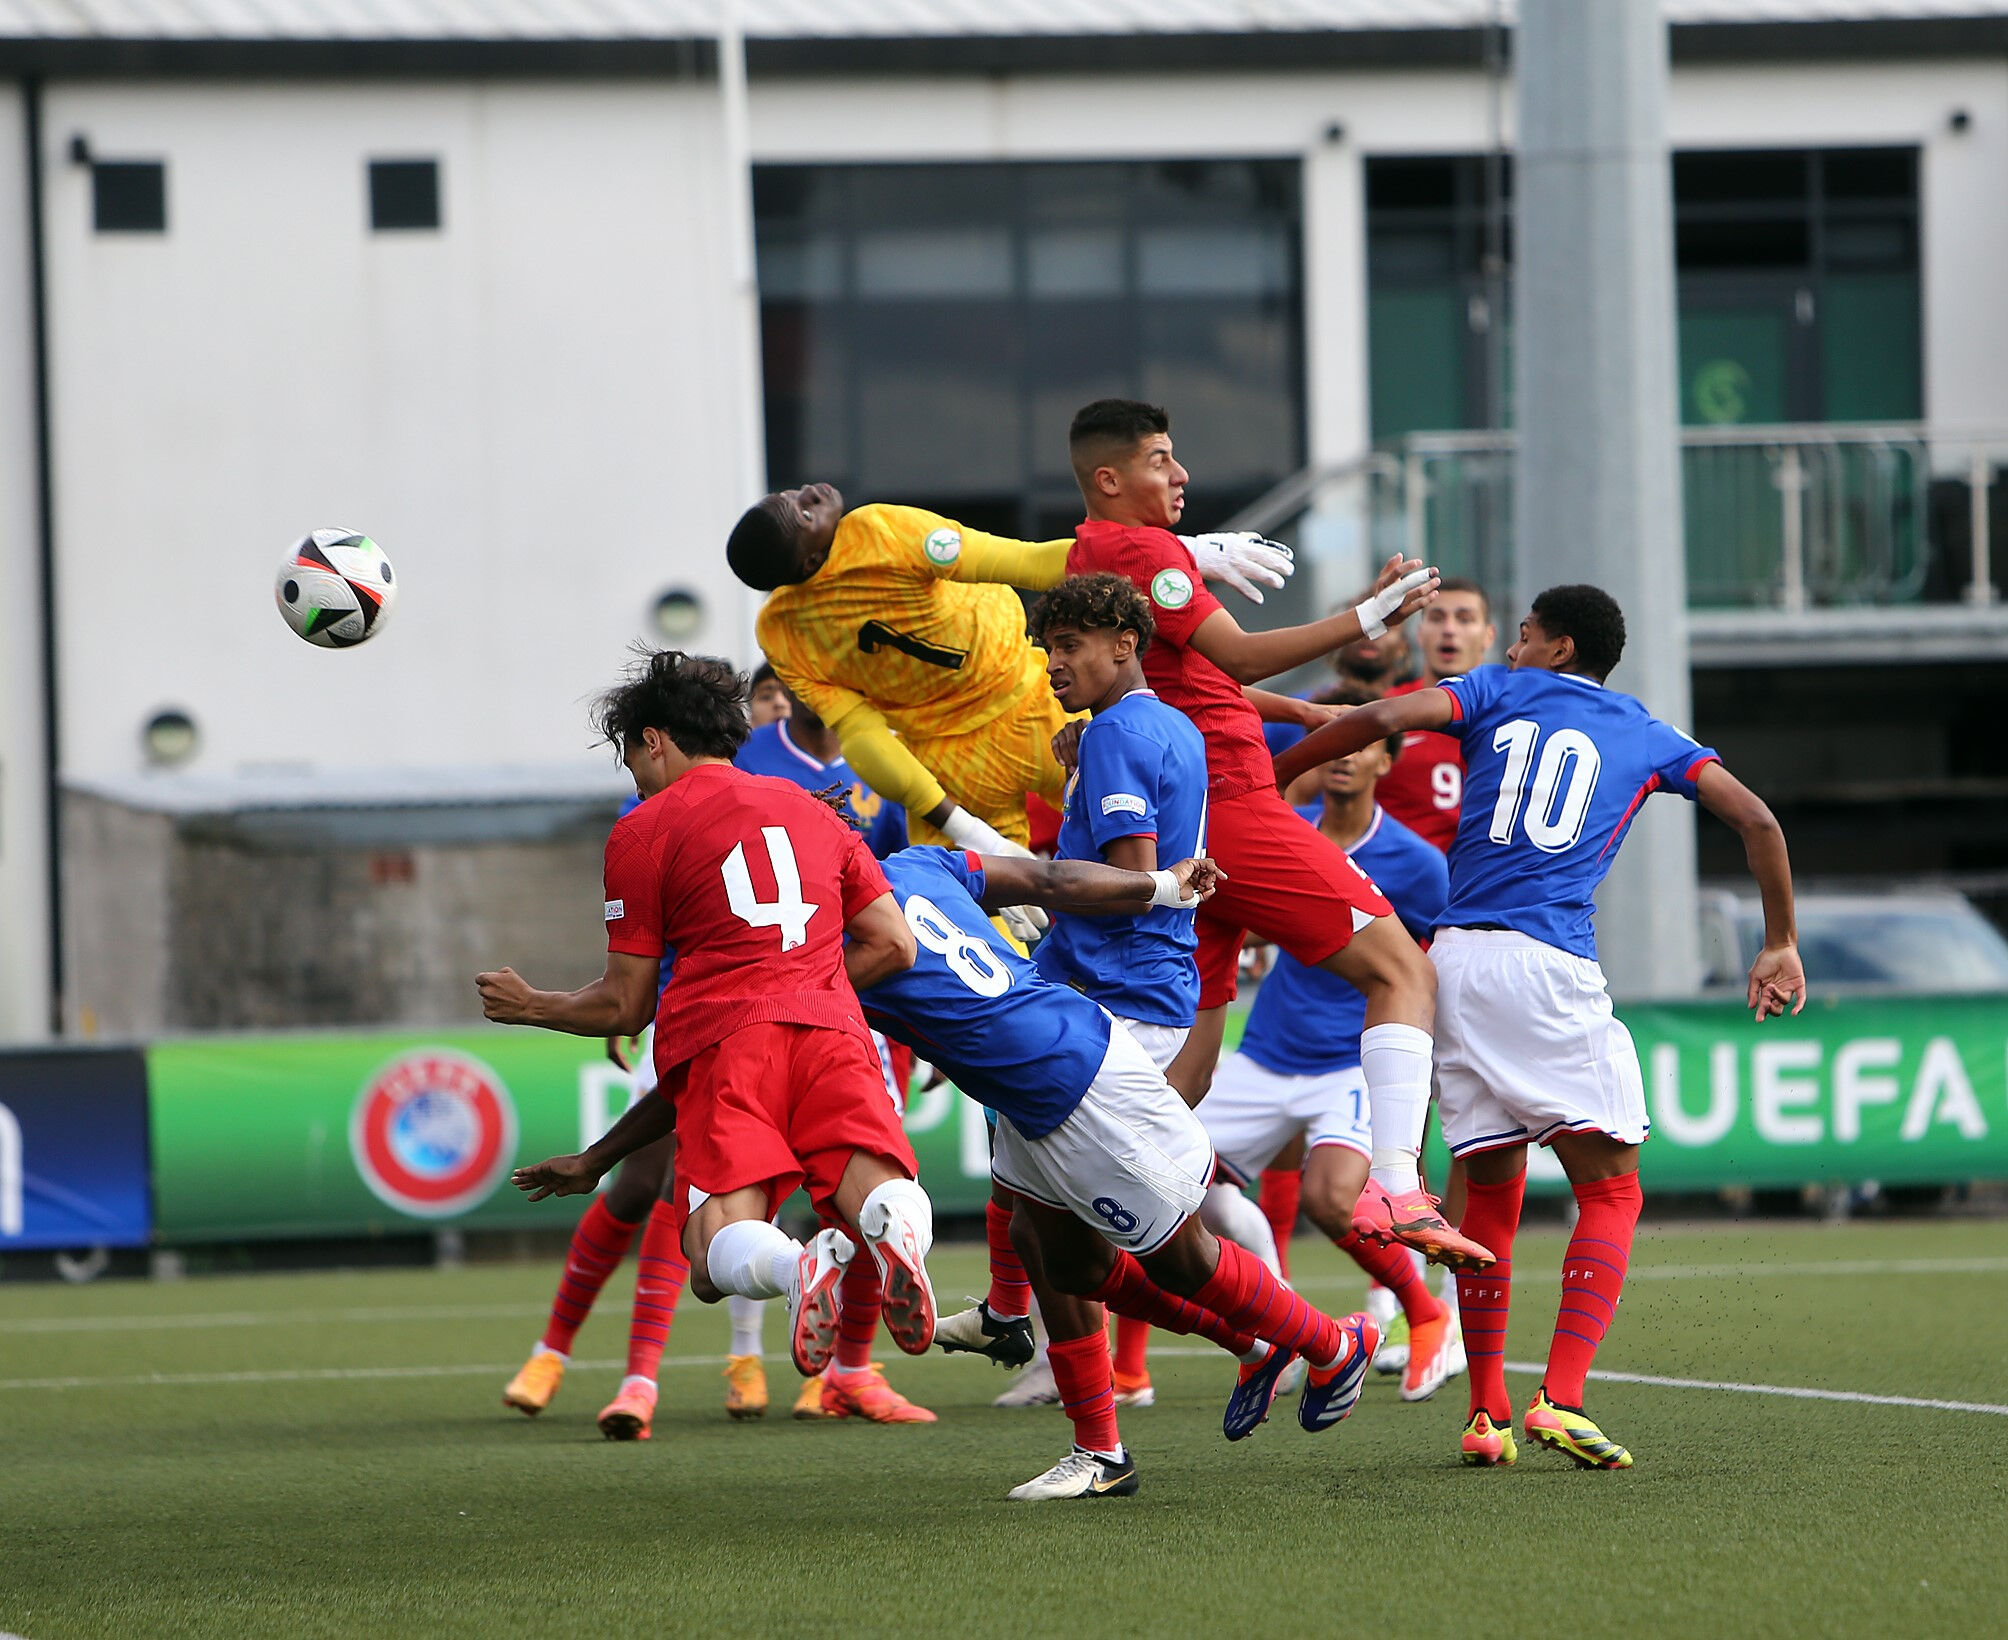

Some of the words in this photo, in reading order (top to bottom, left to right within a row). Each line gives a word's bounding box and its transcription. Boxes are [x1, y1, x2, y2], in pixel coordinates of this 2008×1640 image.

[858, 619, 969, 670] 1
[1430, 762, 1462, 810] 9
[1488, 719, 1602, 854] 10
[720, 826, 820, 953] 4
[904, 894, 1015, 998] 8
[1650, 1036, 1989, 1147] UEFA
[1091, 1196, 1141, 1233] 8
